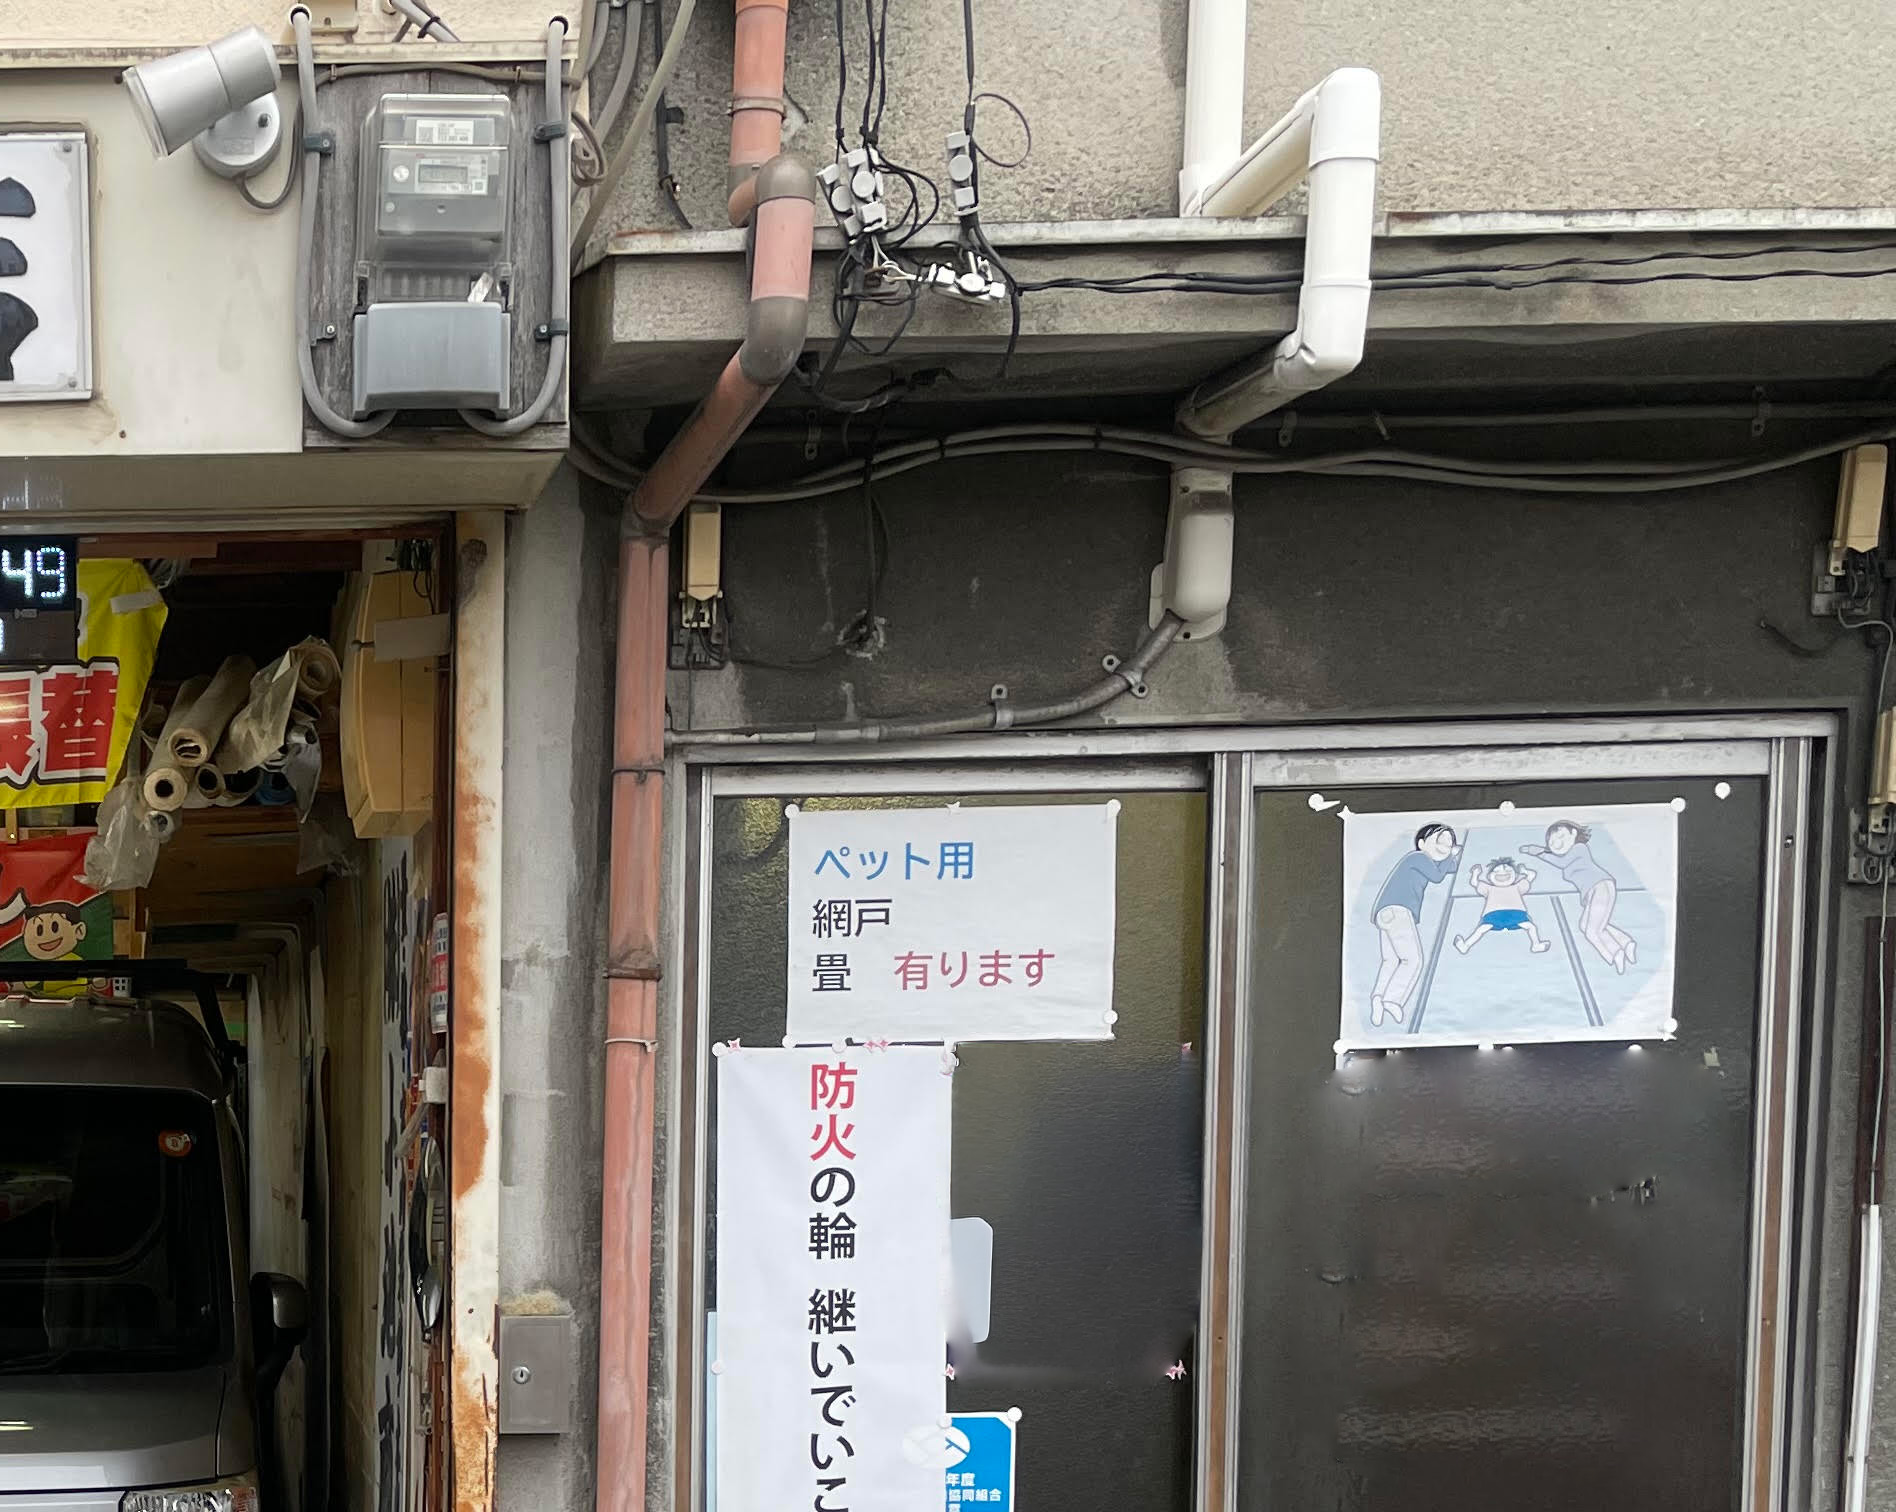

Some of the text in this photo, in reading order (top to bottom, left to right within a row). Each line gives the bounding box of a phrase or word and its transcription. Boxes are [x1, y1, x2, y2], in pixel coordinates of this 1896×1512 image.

[0, 546, 66, 599] 49
[813, 841, 975, 880] ペット用
[811, 898, 893, 939] 網戸
[811, 948, 1055, 993] 畳 有ります
[807, 1061, 858, 1260] 防火の輪
